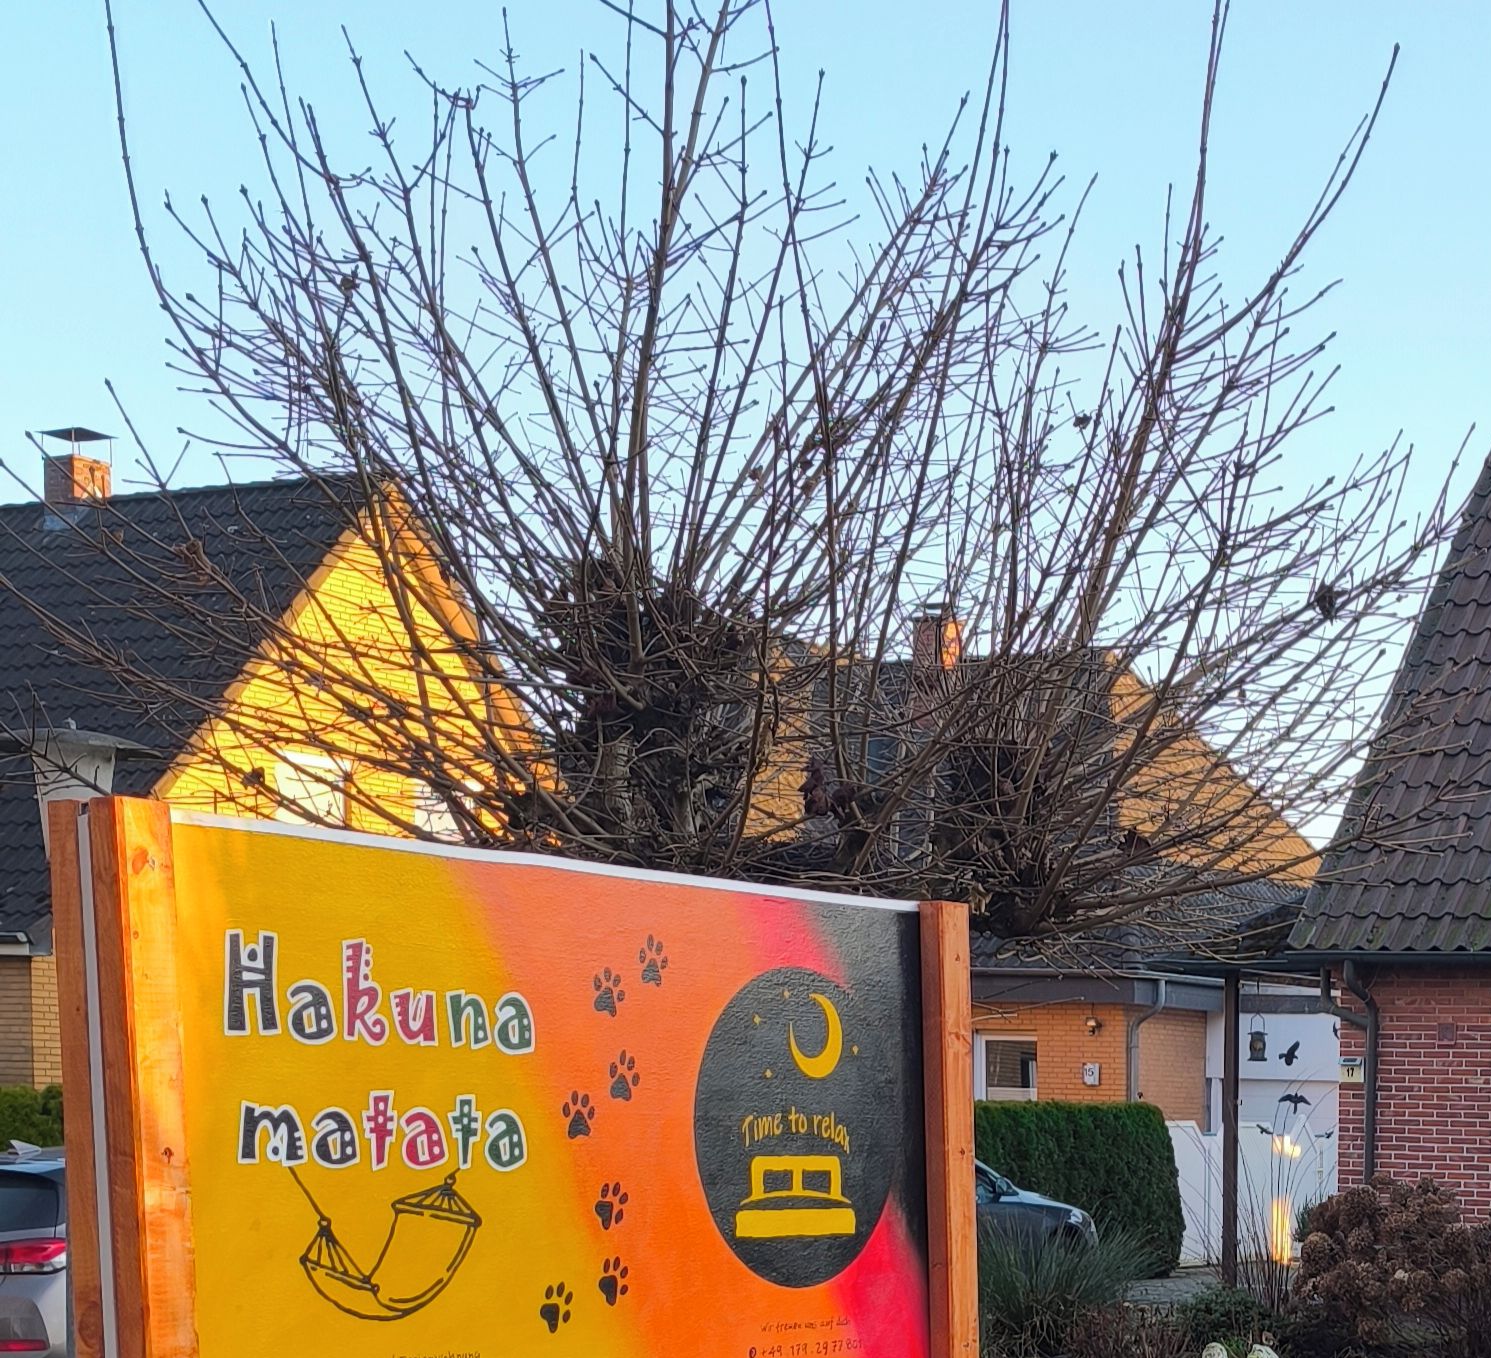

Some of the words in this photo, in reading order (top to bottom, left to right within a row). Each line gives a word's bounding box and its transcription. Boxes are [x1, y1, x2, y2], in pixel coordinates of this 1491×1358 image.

[224, 928, 536, 1055] Hakuna
[1085, 1067, 1095, 1077] 15
[1346, 1066, 1355, 1078] 17
[237, 1090, 528, 1172] matata
[741, 1111, 784, 1148] Time
[787, 1105, 808, 1134] to
[813, 1111, 851, 1155] relax
